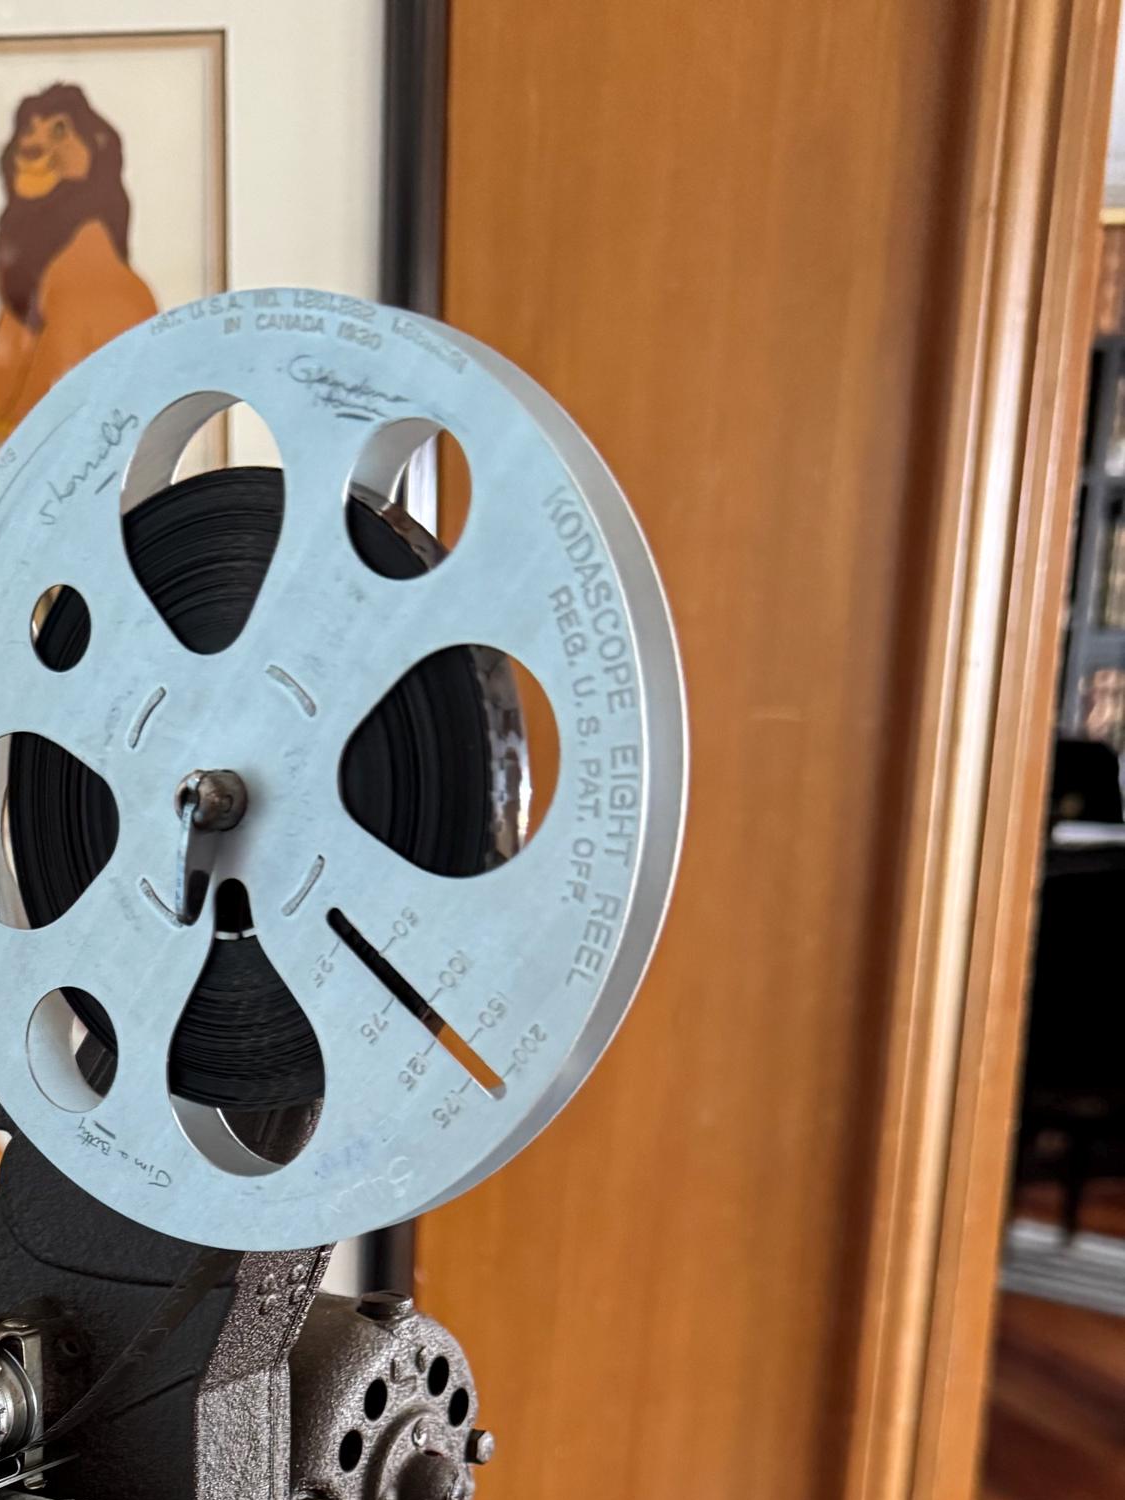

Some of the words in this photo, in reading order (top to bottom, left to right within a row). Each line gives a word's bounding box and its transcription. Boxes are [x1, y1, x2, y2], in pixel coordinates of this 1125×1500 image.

[256, 314, 325, 334] CANADA
[542, 485, 635, 714] KODASCOPE
[549, 585, 588, 666] REG.
[577, 758, 602, 822] PAT.
[605, 744, 638, 867] EIGHT
[392, 906, 419, 938] 50
[566, 892, 622, 987] REEL
[439, 950, 471, 990] 100
[360, 1013, 389, 1046] 75
[479, 991, 508, 1029] 150
[398, 1051, 427, 1091] 125
[432, 1090, 461, 1130] 175
